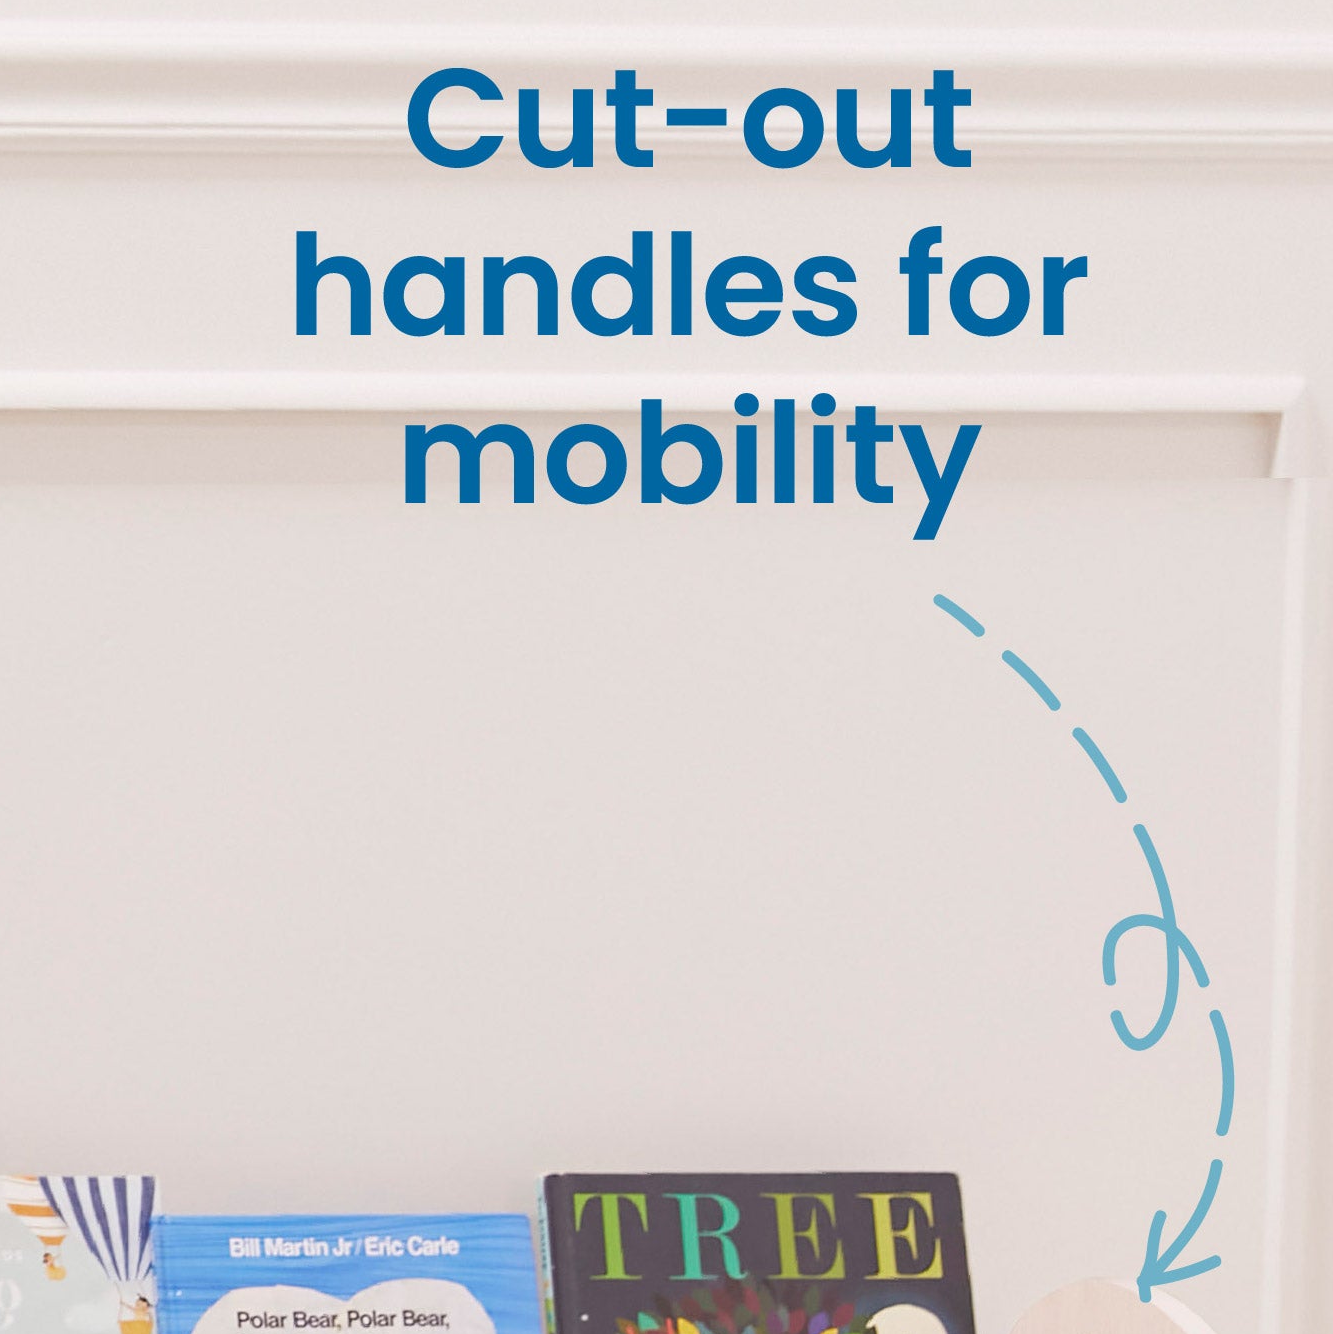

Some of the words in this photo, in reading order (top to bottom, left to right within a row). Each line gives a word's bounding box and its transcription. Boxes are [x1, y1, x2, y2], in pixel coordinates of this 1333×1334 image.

[229, 1237, 260, 1258] Bill
[264, 1236, 328, 1258] Martin
[406, 1234, 460, 1256] Carle
[573, 1192, 944, 1281] TREE
[237, 1311, 287, 1329] Polar
[293, 1311, 342, 1331] Bear,
[347, 1309, 396, 1328] Polar
[402, 1308, 450, 1330] Bear,
